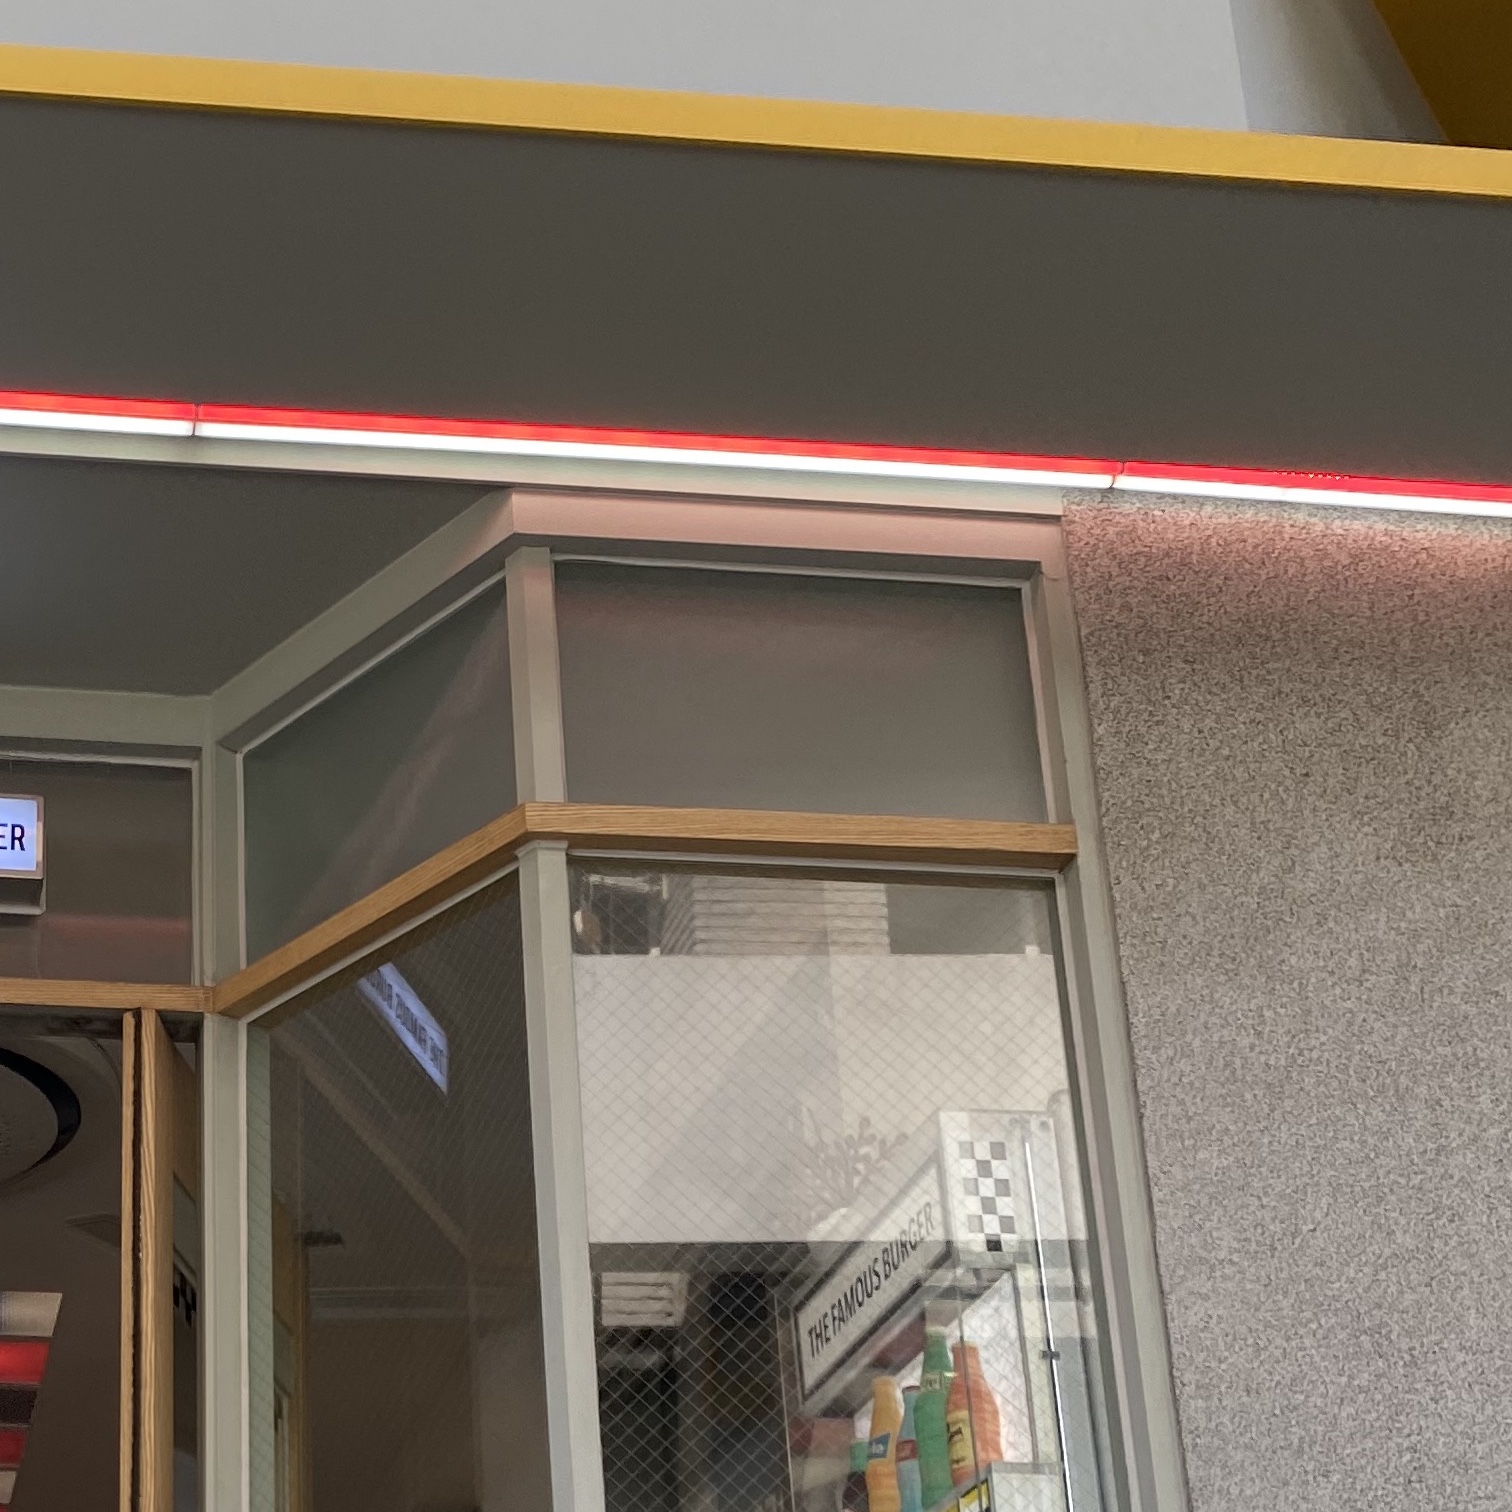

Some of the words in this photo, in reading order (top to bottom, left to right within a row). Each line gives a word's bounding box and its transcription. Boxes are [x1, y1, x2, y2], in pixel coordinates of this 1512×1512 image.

[807, 1311, 832, 1358] THE
[830, 1256, 882, 1335] FAMOUS
[881, 1201, 937, 1280] BURGER
